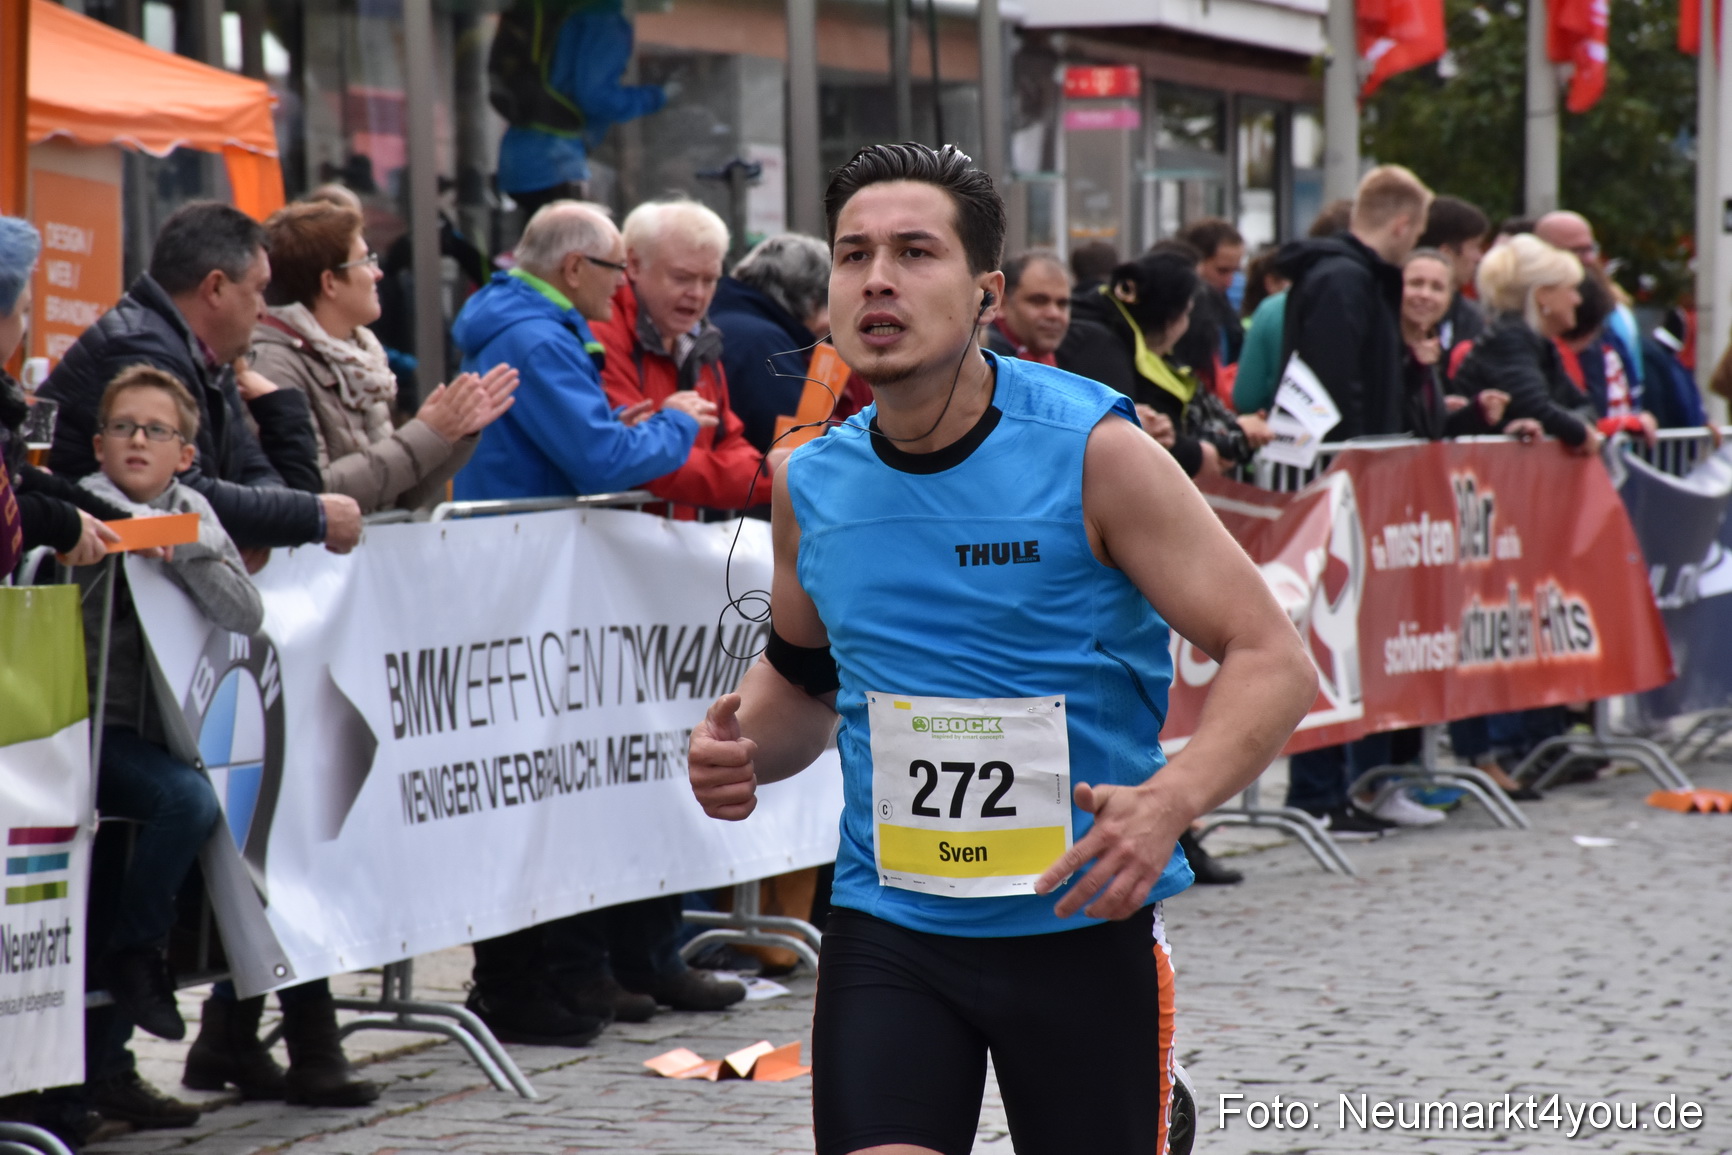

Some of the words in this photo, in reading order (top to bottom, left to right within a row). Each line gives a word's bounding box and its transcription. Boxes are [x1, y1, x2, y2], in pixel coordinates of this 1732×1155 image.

[955, 540, 1040, 567] THULE
[191, 631, 281, 716] BMW
[385, 645, 463, 740] BMW
[931, 717, 1003, 733] BOCK
[399, 764, 482, 826] WENIGER
[909, 759, 1017, 819] 272
[939, 841, 988, 863] Sven
